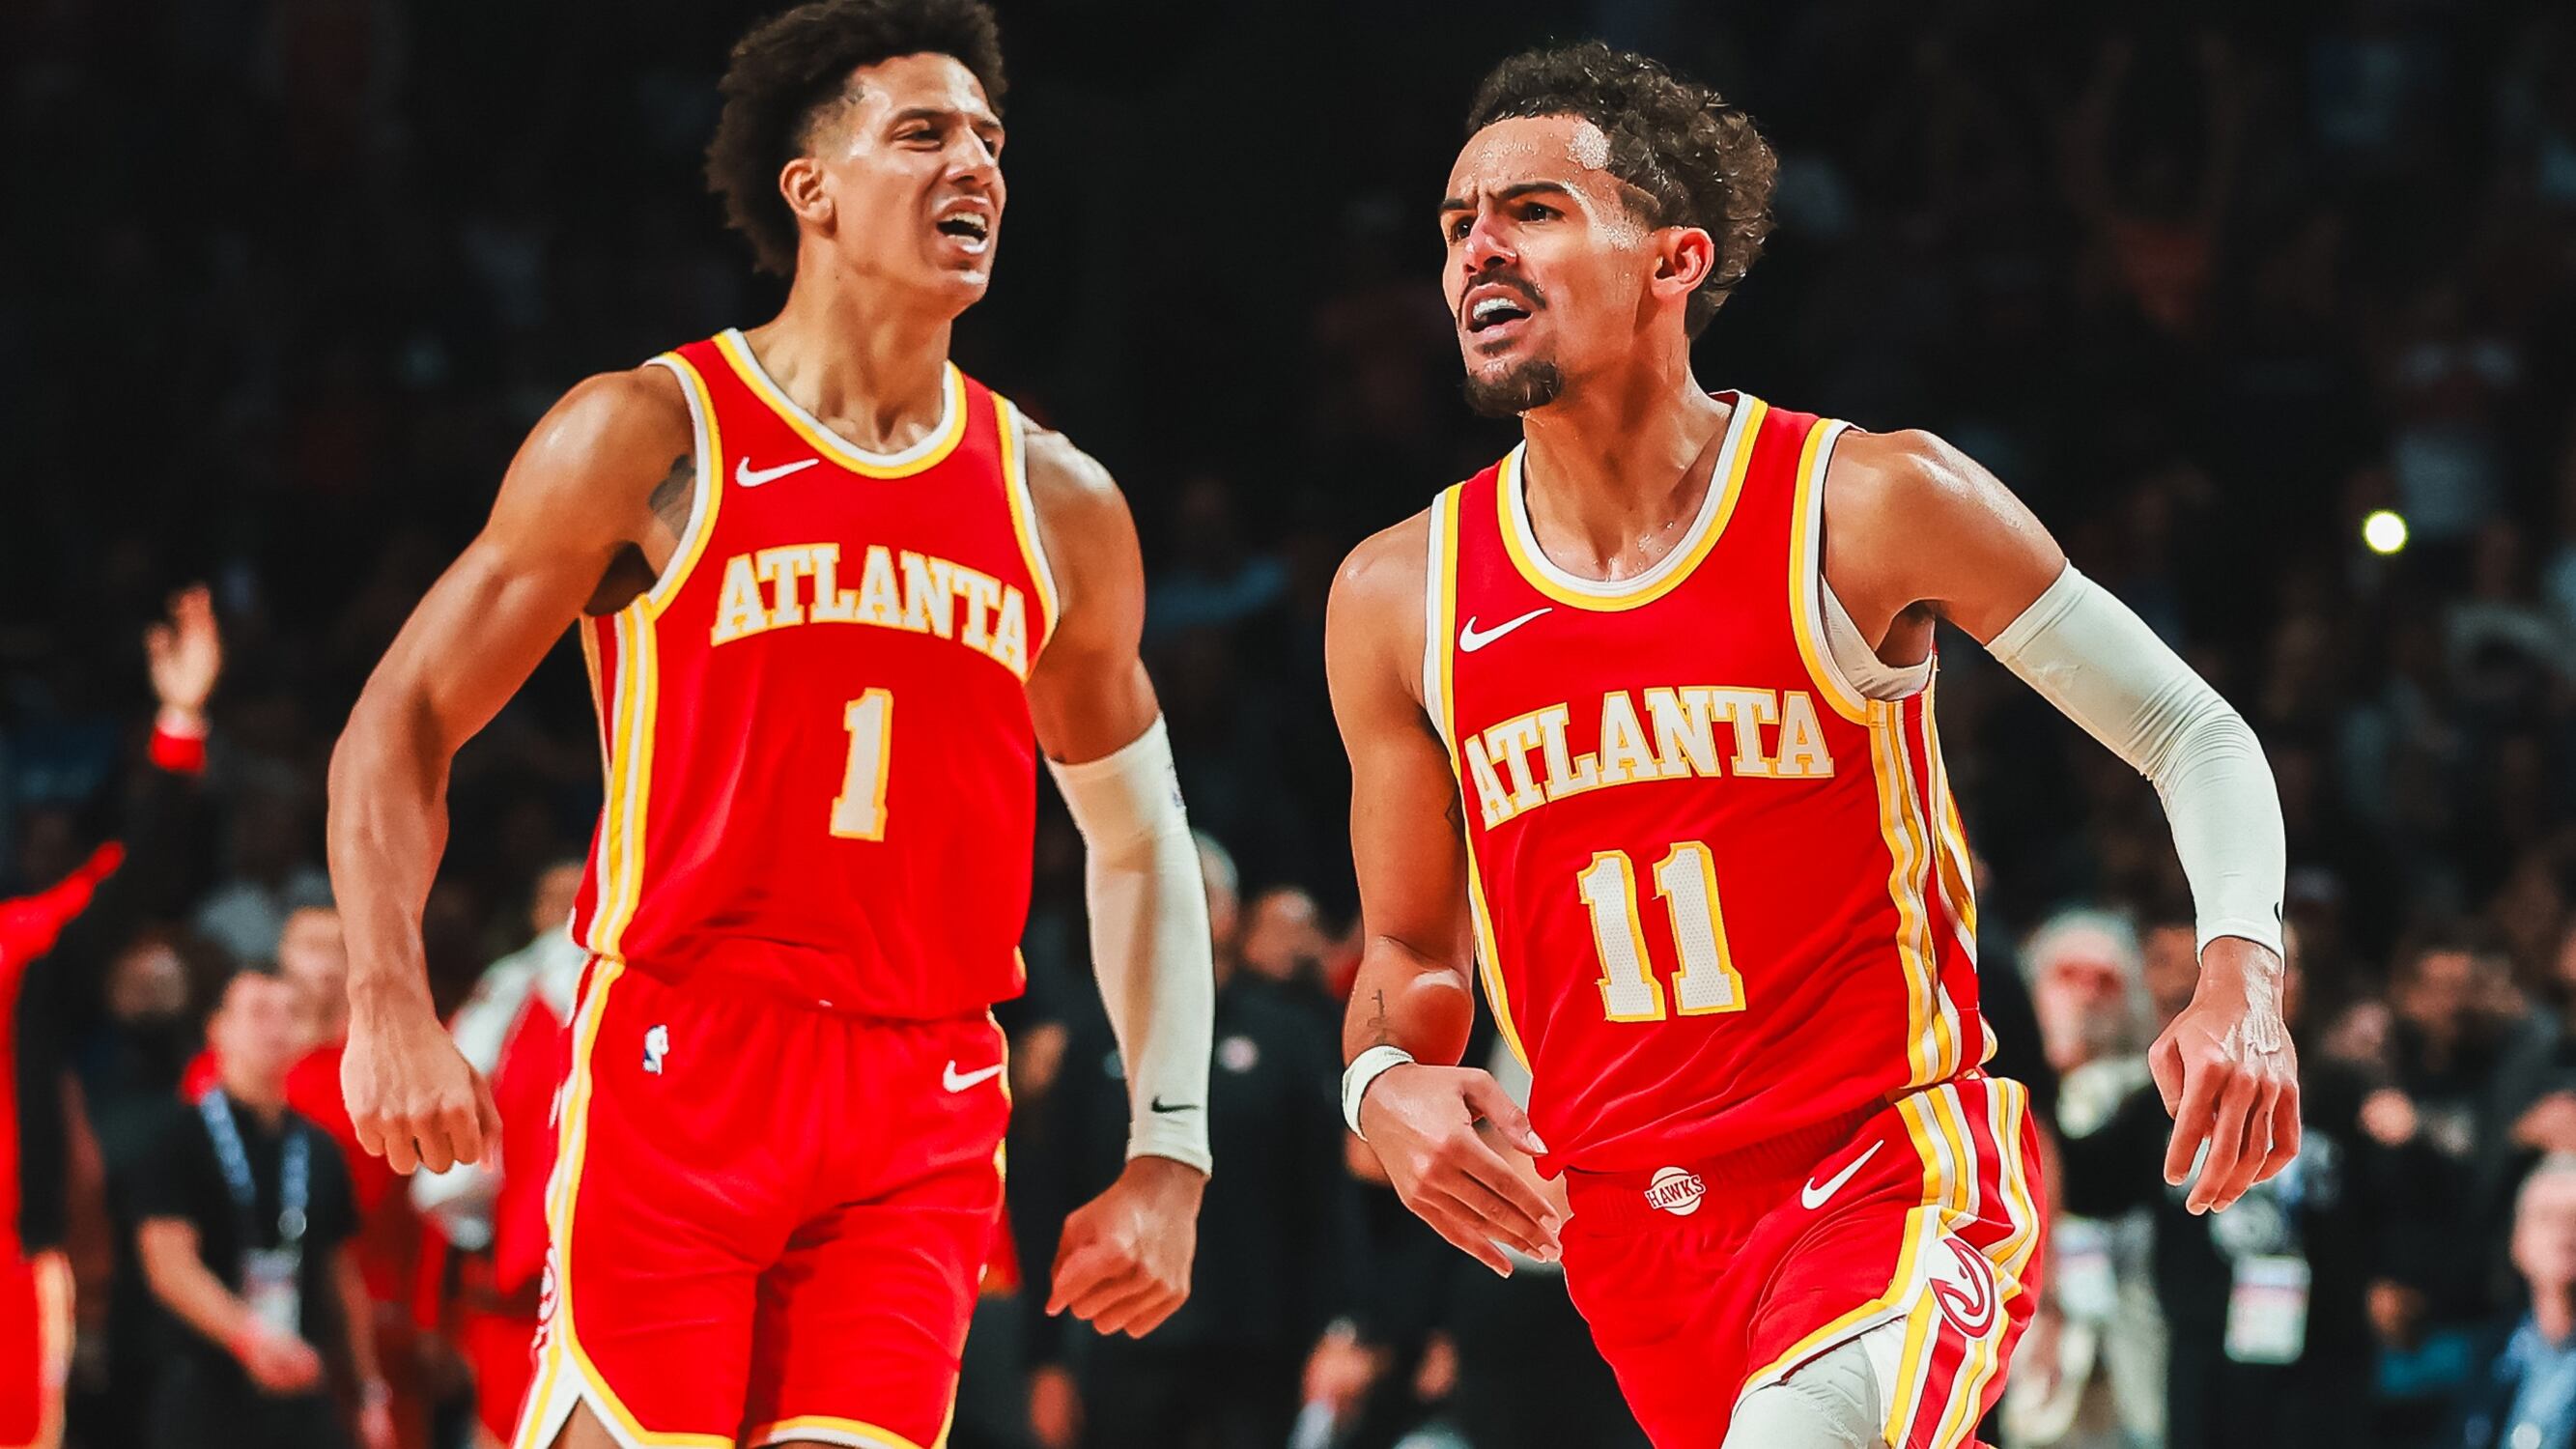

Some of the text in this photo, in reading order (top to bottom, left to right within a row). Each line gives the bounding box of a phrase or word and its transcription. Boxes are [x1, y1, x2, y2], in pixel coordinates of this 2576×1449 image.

[710, 542, 1029, 684] ATLANTA
[829, 687, 893, 842] 1
[1464, 685, 1835, 831] ATLANTA
[1576, 840, 1746, 1022] 11
[1646, 1176, 1704, 1208] HAWKS
